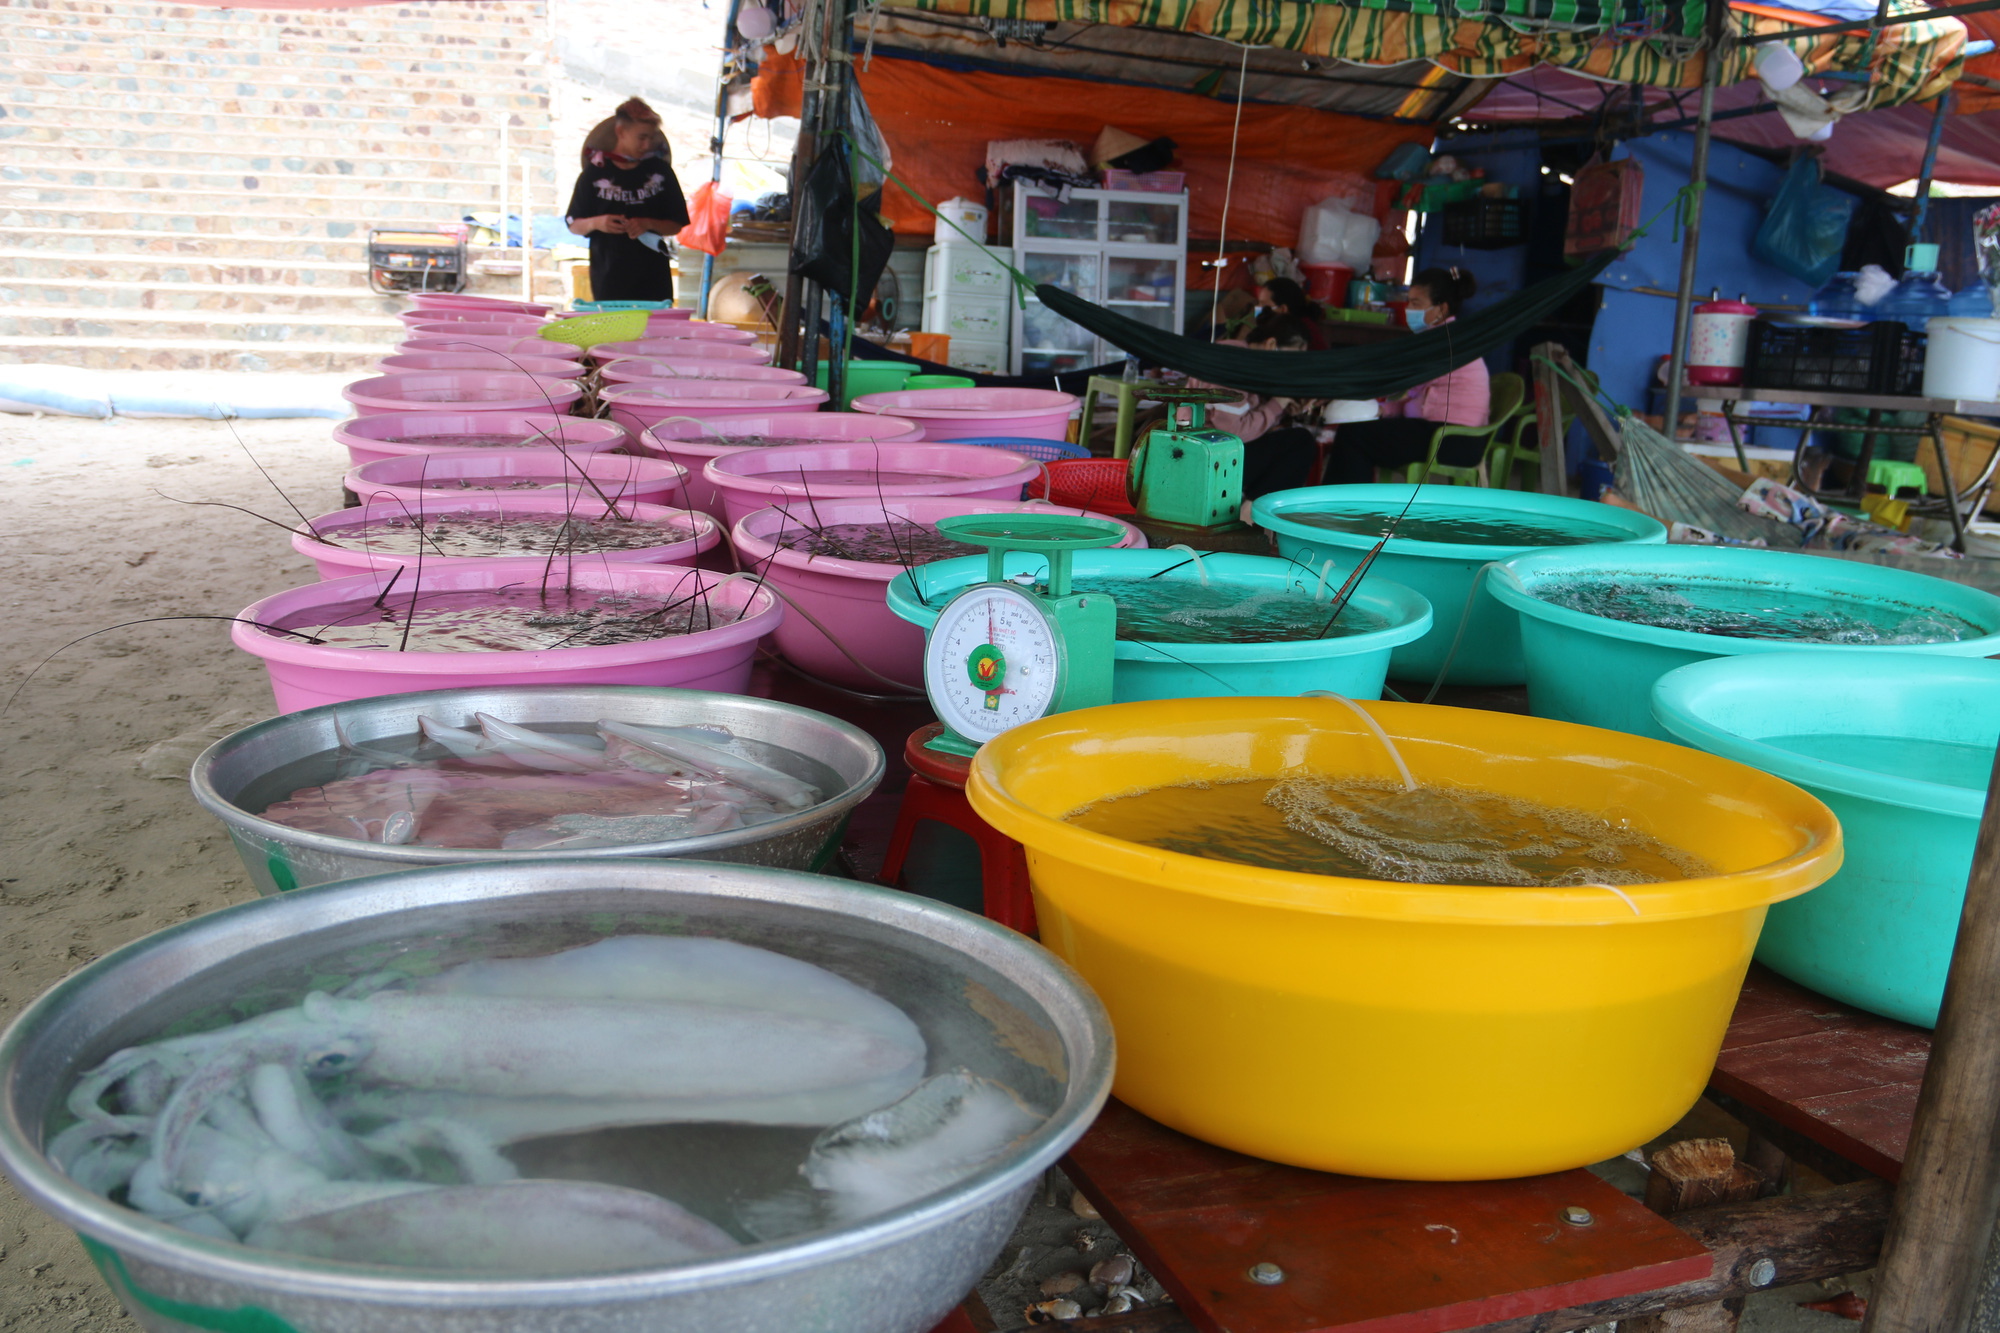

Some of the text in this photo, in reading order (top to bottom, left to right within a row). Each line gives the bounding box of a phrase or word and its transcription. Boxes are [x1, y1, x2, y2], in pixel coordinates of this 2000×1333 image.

[597, 187, 636, 202] ANGEL
[1000, 616, 1012, 628] 5 kg
[956, 638, 961, 646] 4
[1039, 657, 1045, 665] kg
[964, 696, 970, 705] 3
[1012, 706, 1019, 715] 2
